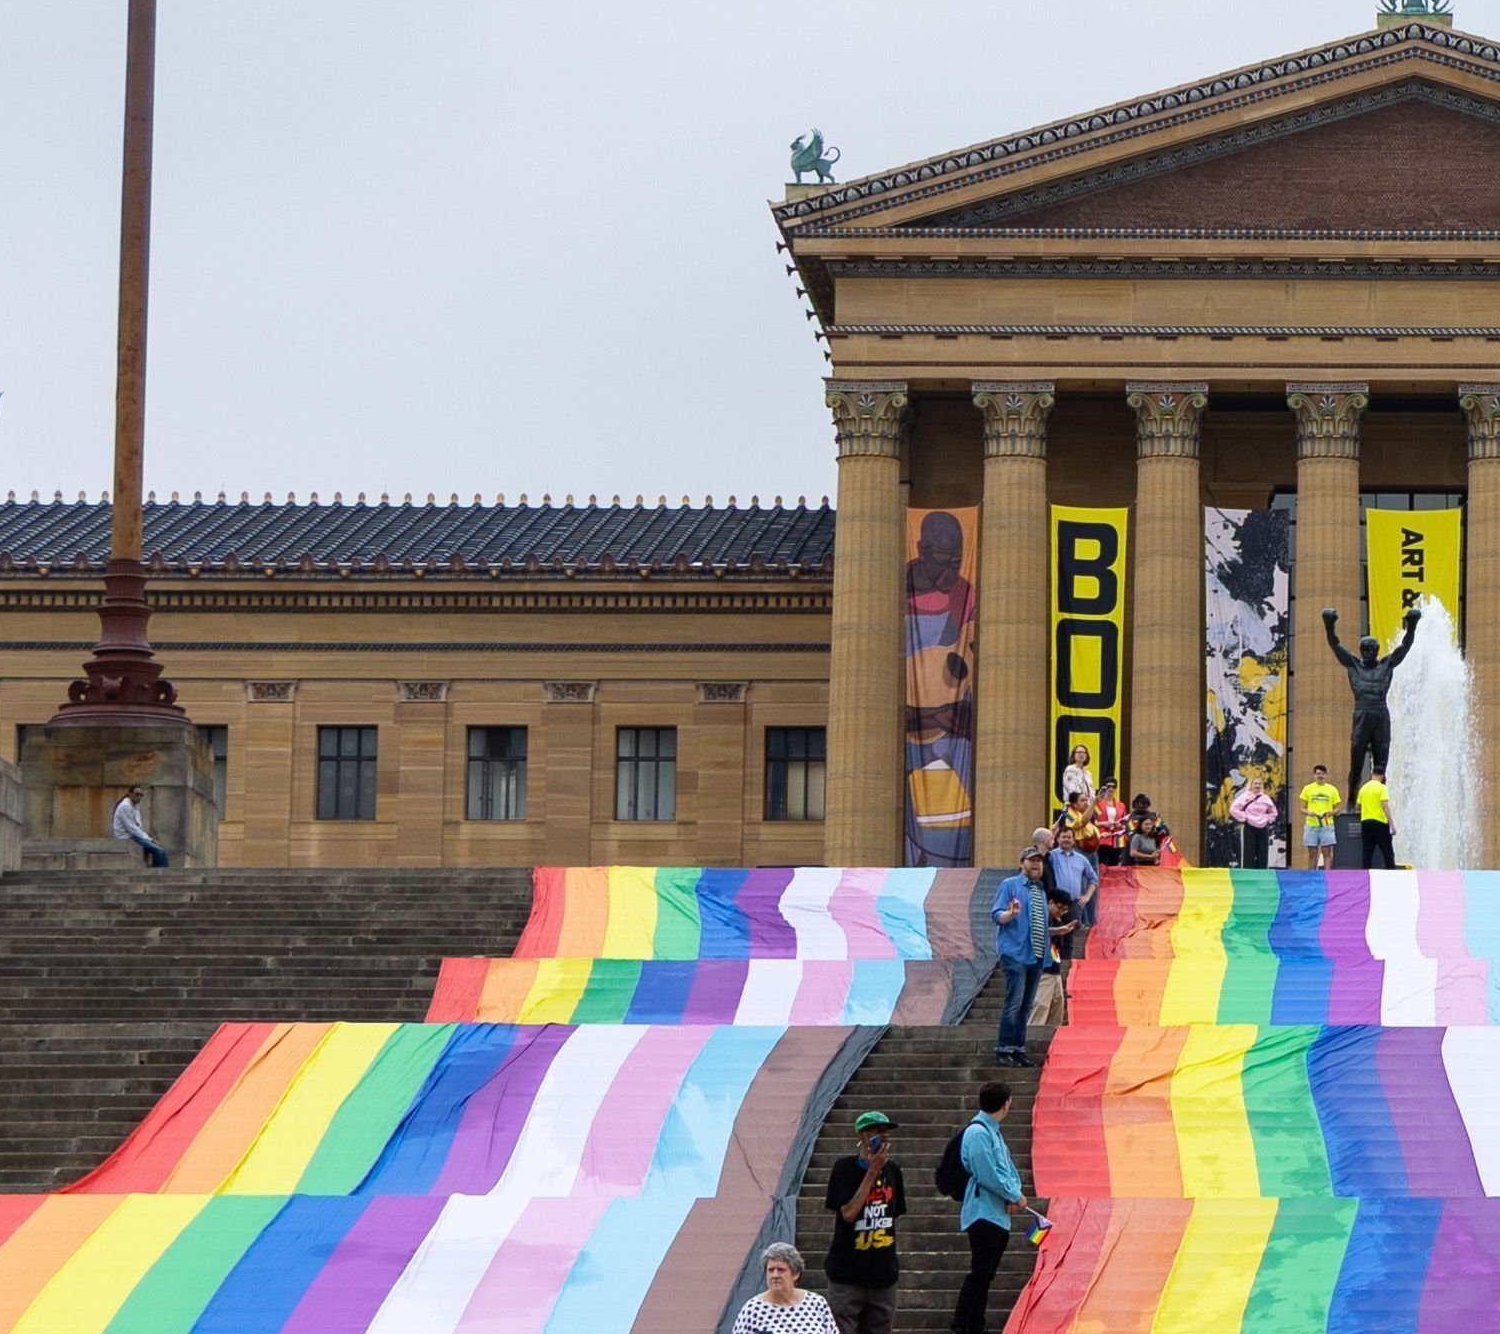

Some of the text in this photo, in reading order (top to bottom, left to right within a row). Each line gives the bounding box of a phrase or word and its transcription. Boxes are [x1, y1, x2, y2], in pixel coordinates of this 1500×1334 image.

[1401, 527, 1424, 582] ART
[1055, 520, 1119, 827] BOO
[864, 1204, 888, 1219] NOT
[862, 1217, 891, 1230] LIKE
[857, 1229, 891, 1250] US
